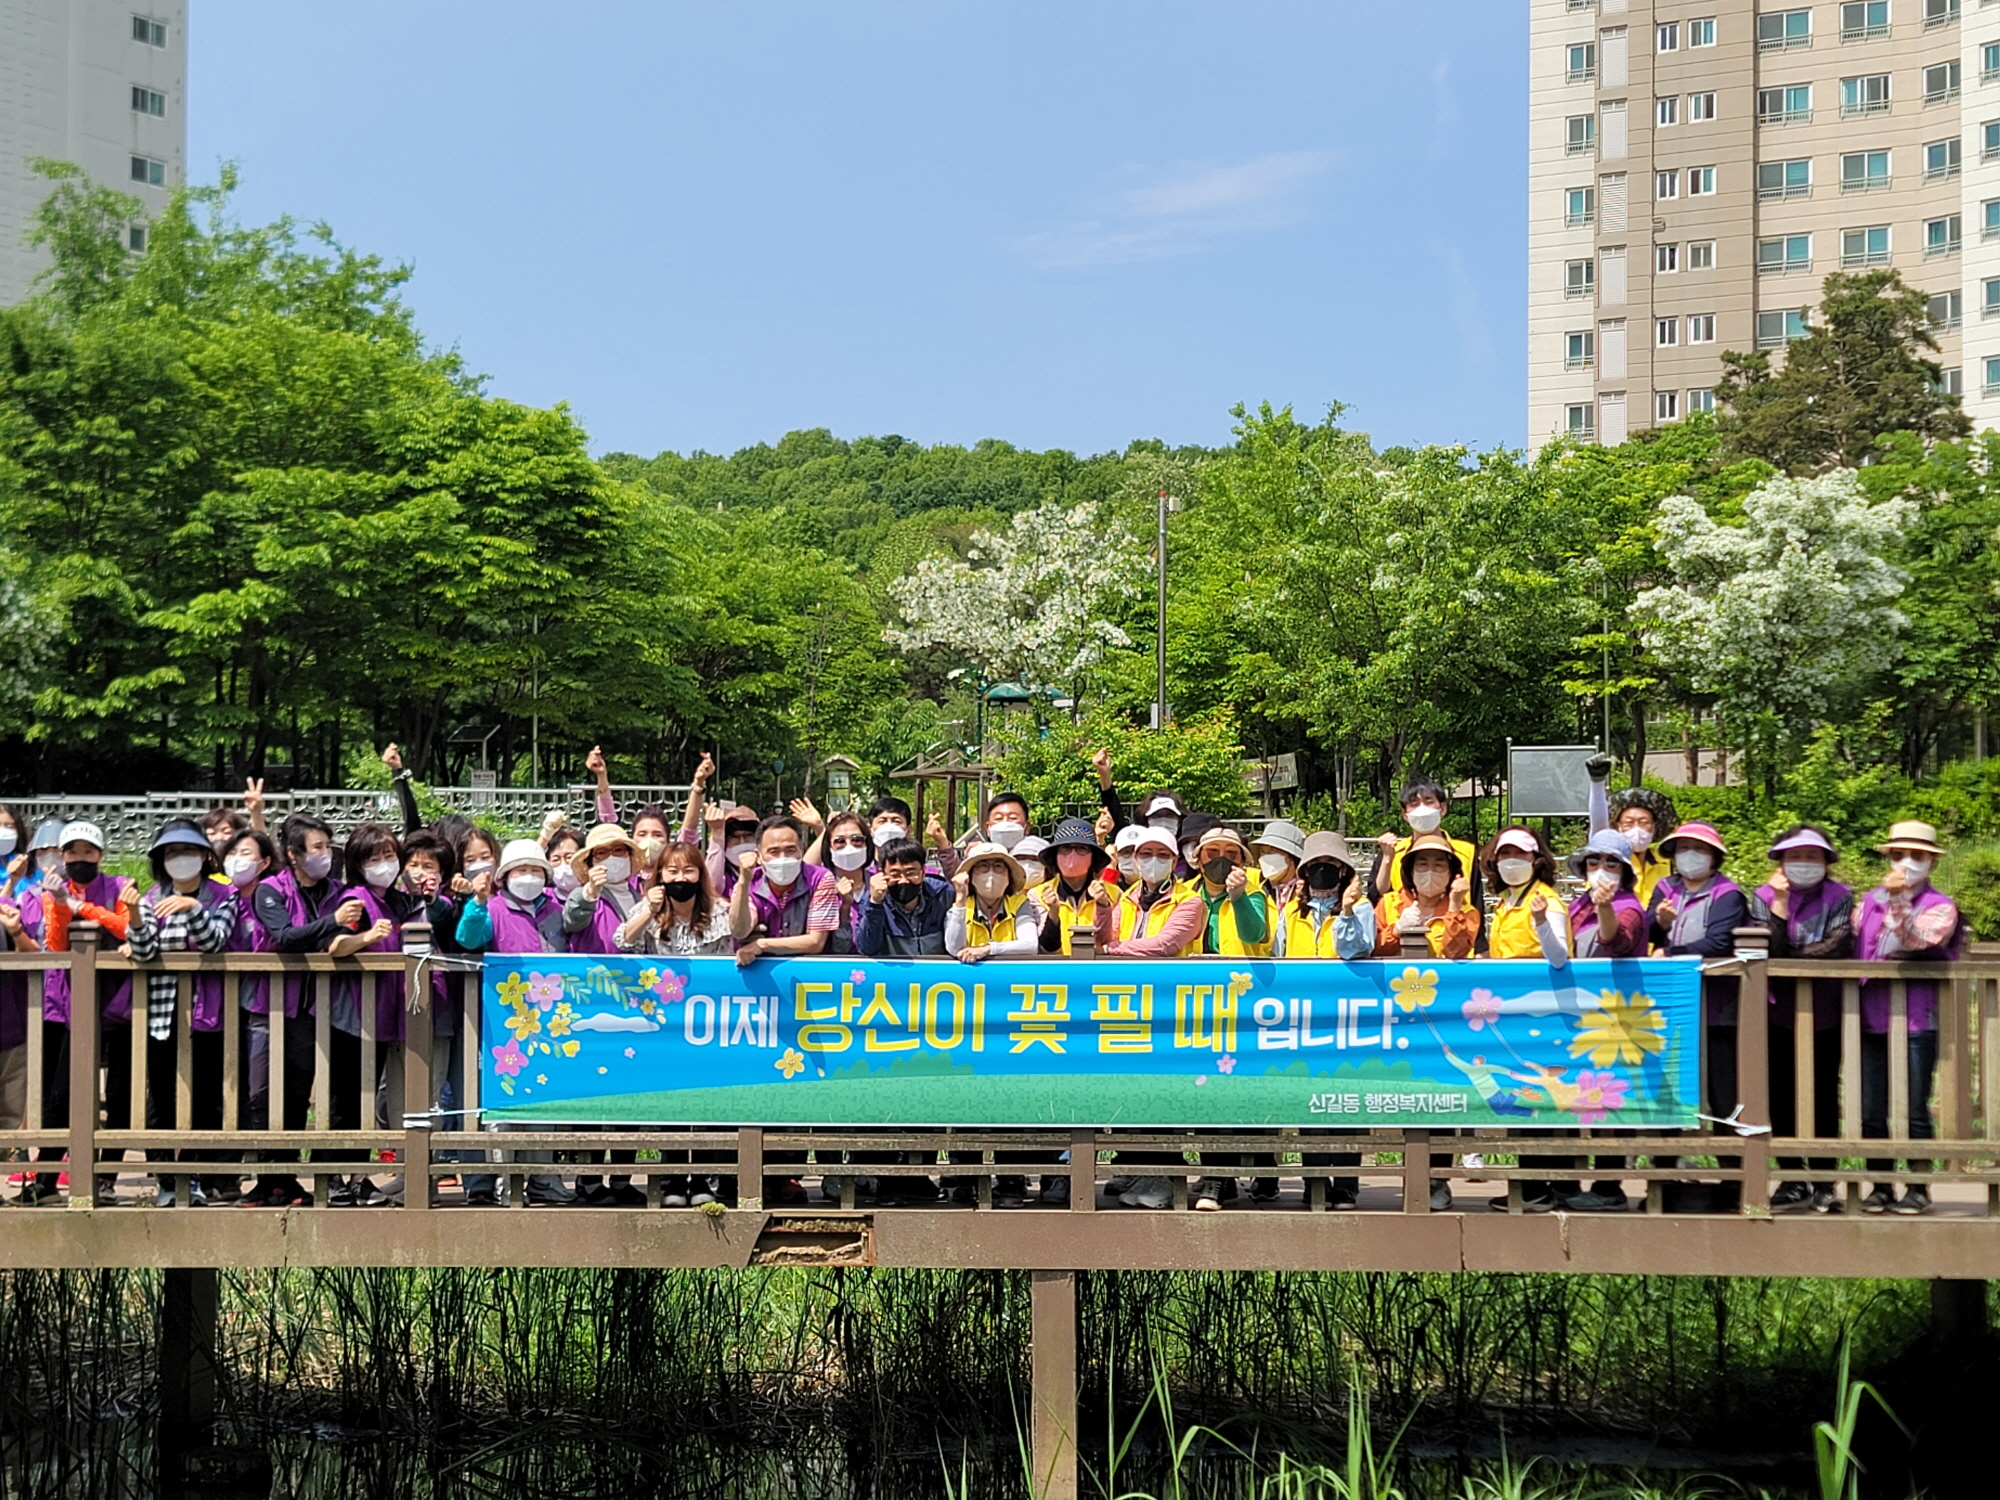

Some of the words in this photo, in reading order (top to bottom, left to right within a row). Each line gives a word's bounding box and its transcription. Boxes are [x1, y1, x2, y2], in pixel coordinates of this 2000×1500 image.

[683, 993, 779, 1049] 이제
[794, 981, 986, 1053] 당신이
[1006, 983, 1071, 1055] 꽃
[1089, 983, 1154, 1054] 필
[1173, 983, 1239, 1053] 때
[1252, 996, 1410, 1051] 입니다.
[1308, 1092, 1361, 1114] 신길동
[1363, 1092, 1468, 1114] 행정복지센터
